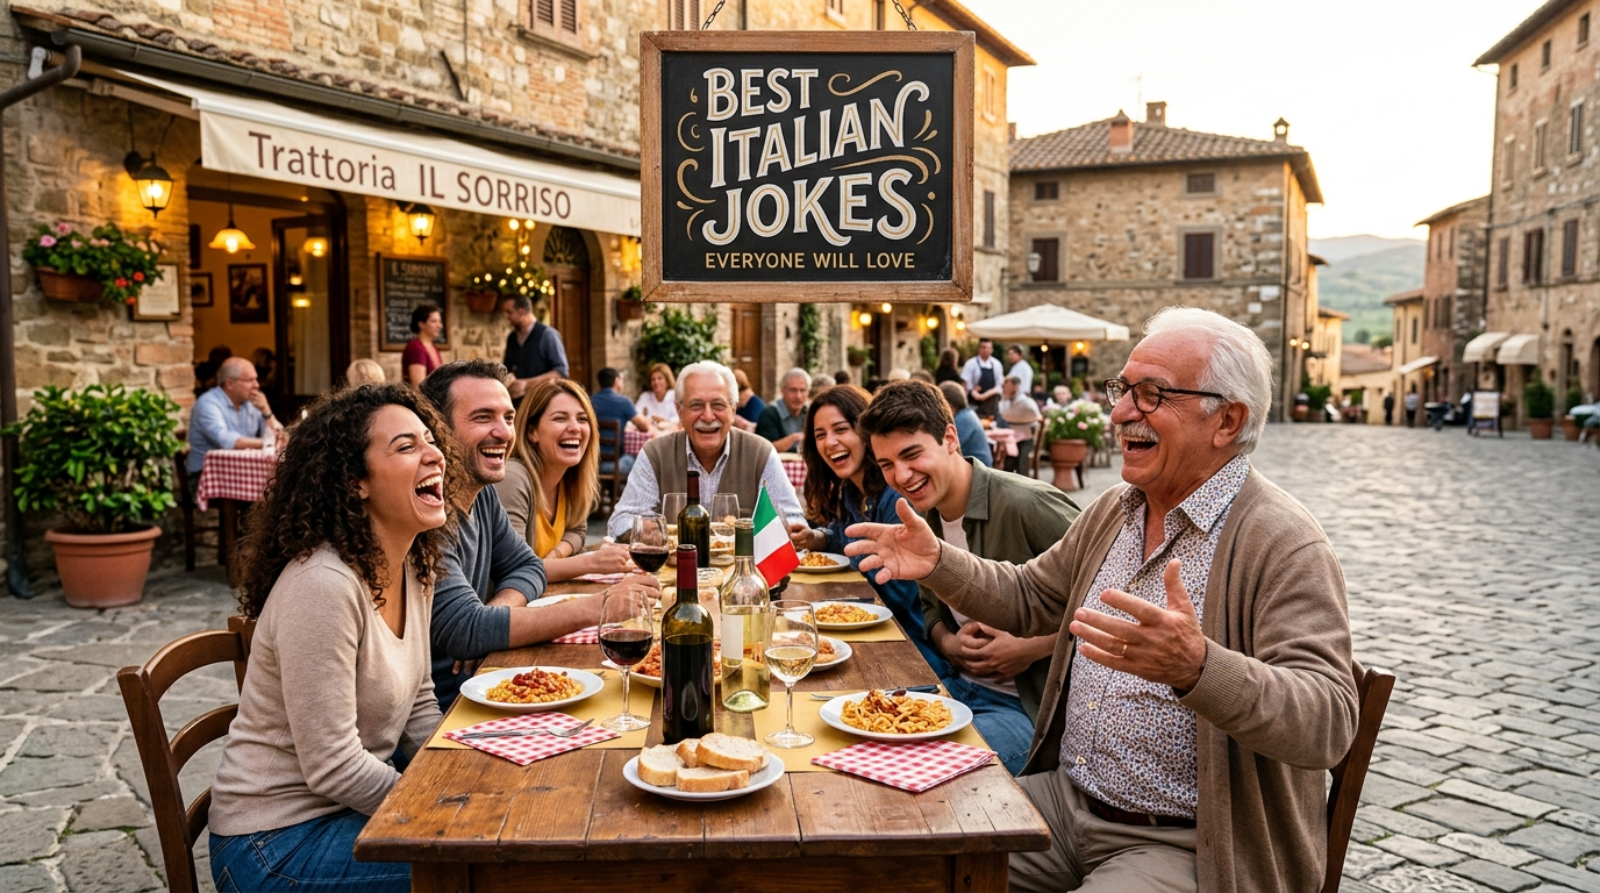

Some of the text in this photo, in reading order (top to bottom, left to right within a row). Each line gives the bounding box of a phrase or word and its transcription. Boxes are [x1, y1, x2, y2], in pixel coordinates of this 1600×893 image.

[703, 67, 819, 121] BEST
[710, 80, 930, 188] ITALIAN
[248, 130, 572, 220] Trattoria IL SORRISO
[702, 168, 917, 246] JOKES
[705, 252, 916, 269] EVERYONE WILL LOVE
